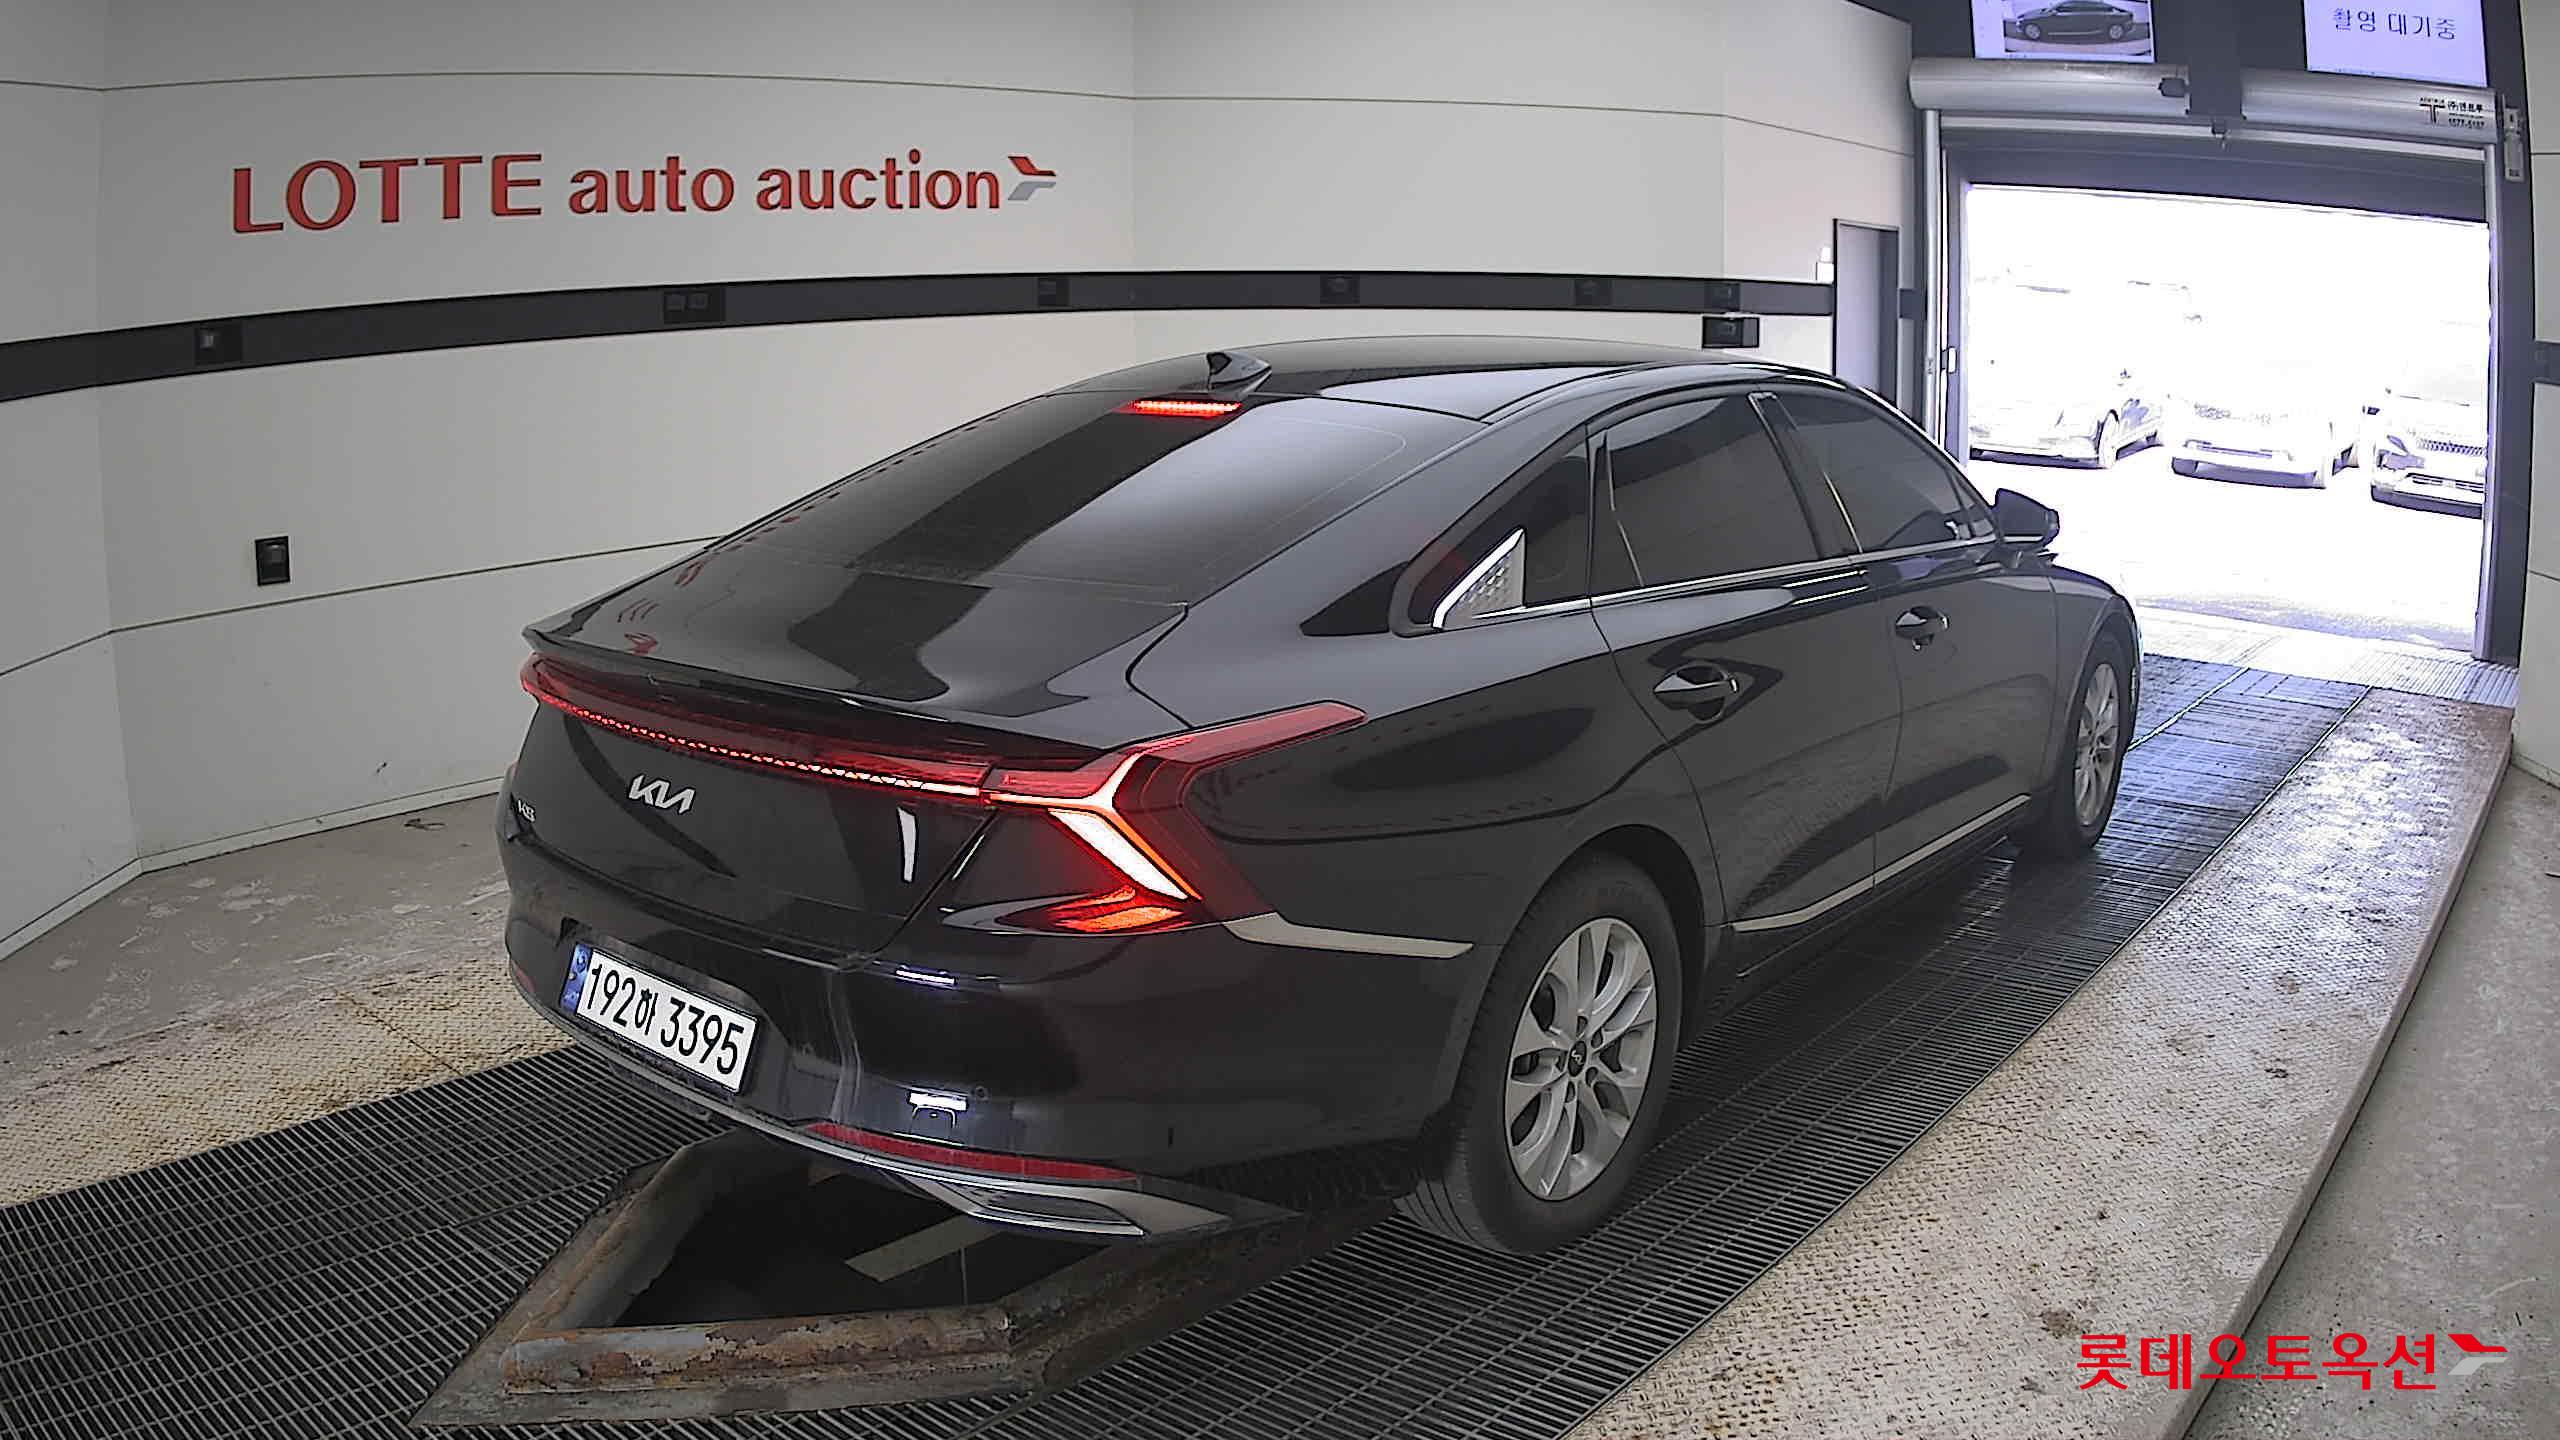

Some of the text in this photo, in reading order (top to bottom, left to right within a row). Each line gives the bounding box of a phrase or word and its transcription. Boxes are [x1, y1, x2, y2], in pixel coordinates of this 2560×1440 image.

[2388, 12, 2457, 40] 대기중
[233, 148, 1001, 234] LOTTE auto auction
[628, 774, 696, 814] KIA
[587, 963, 745, 1075] 192하 3395
